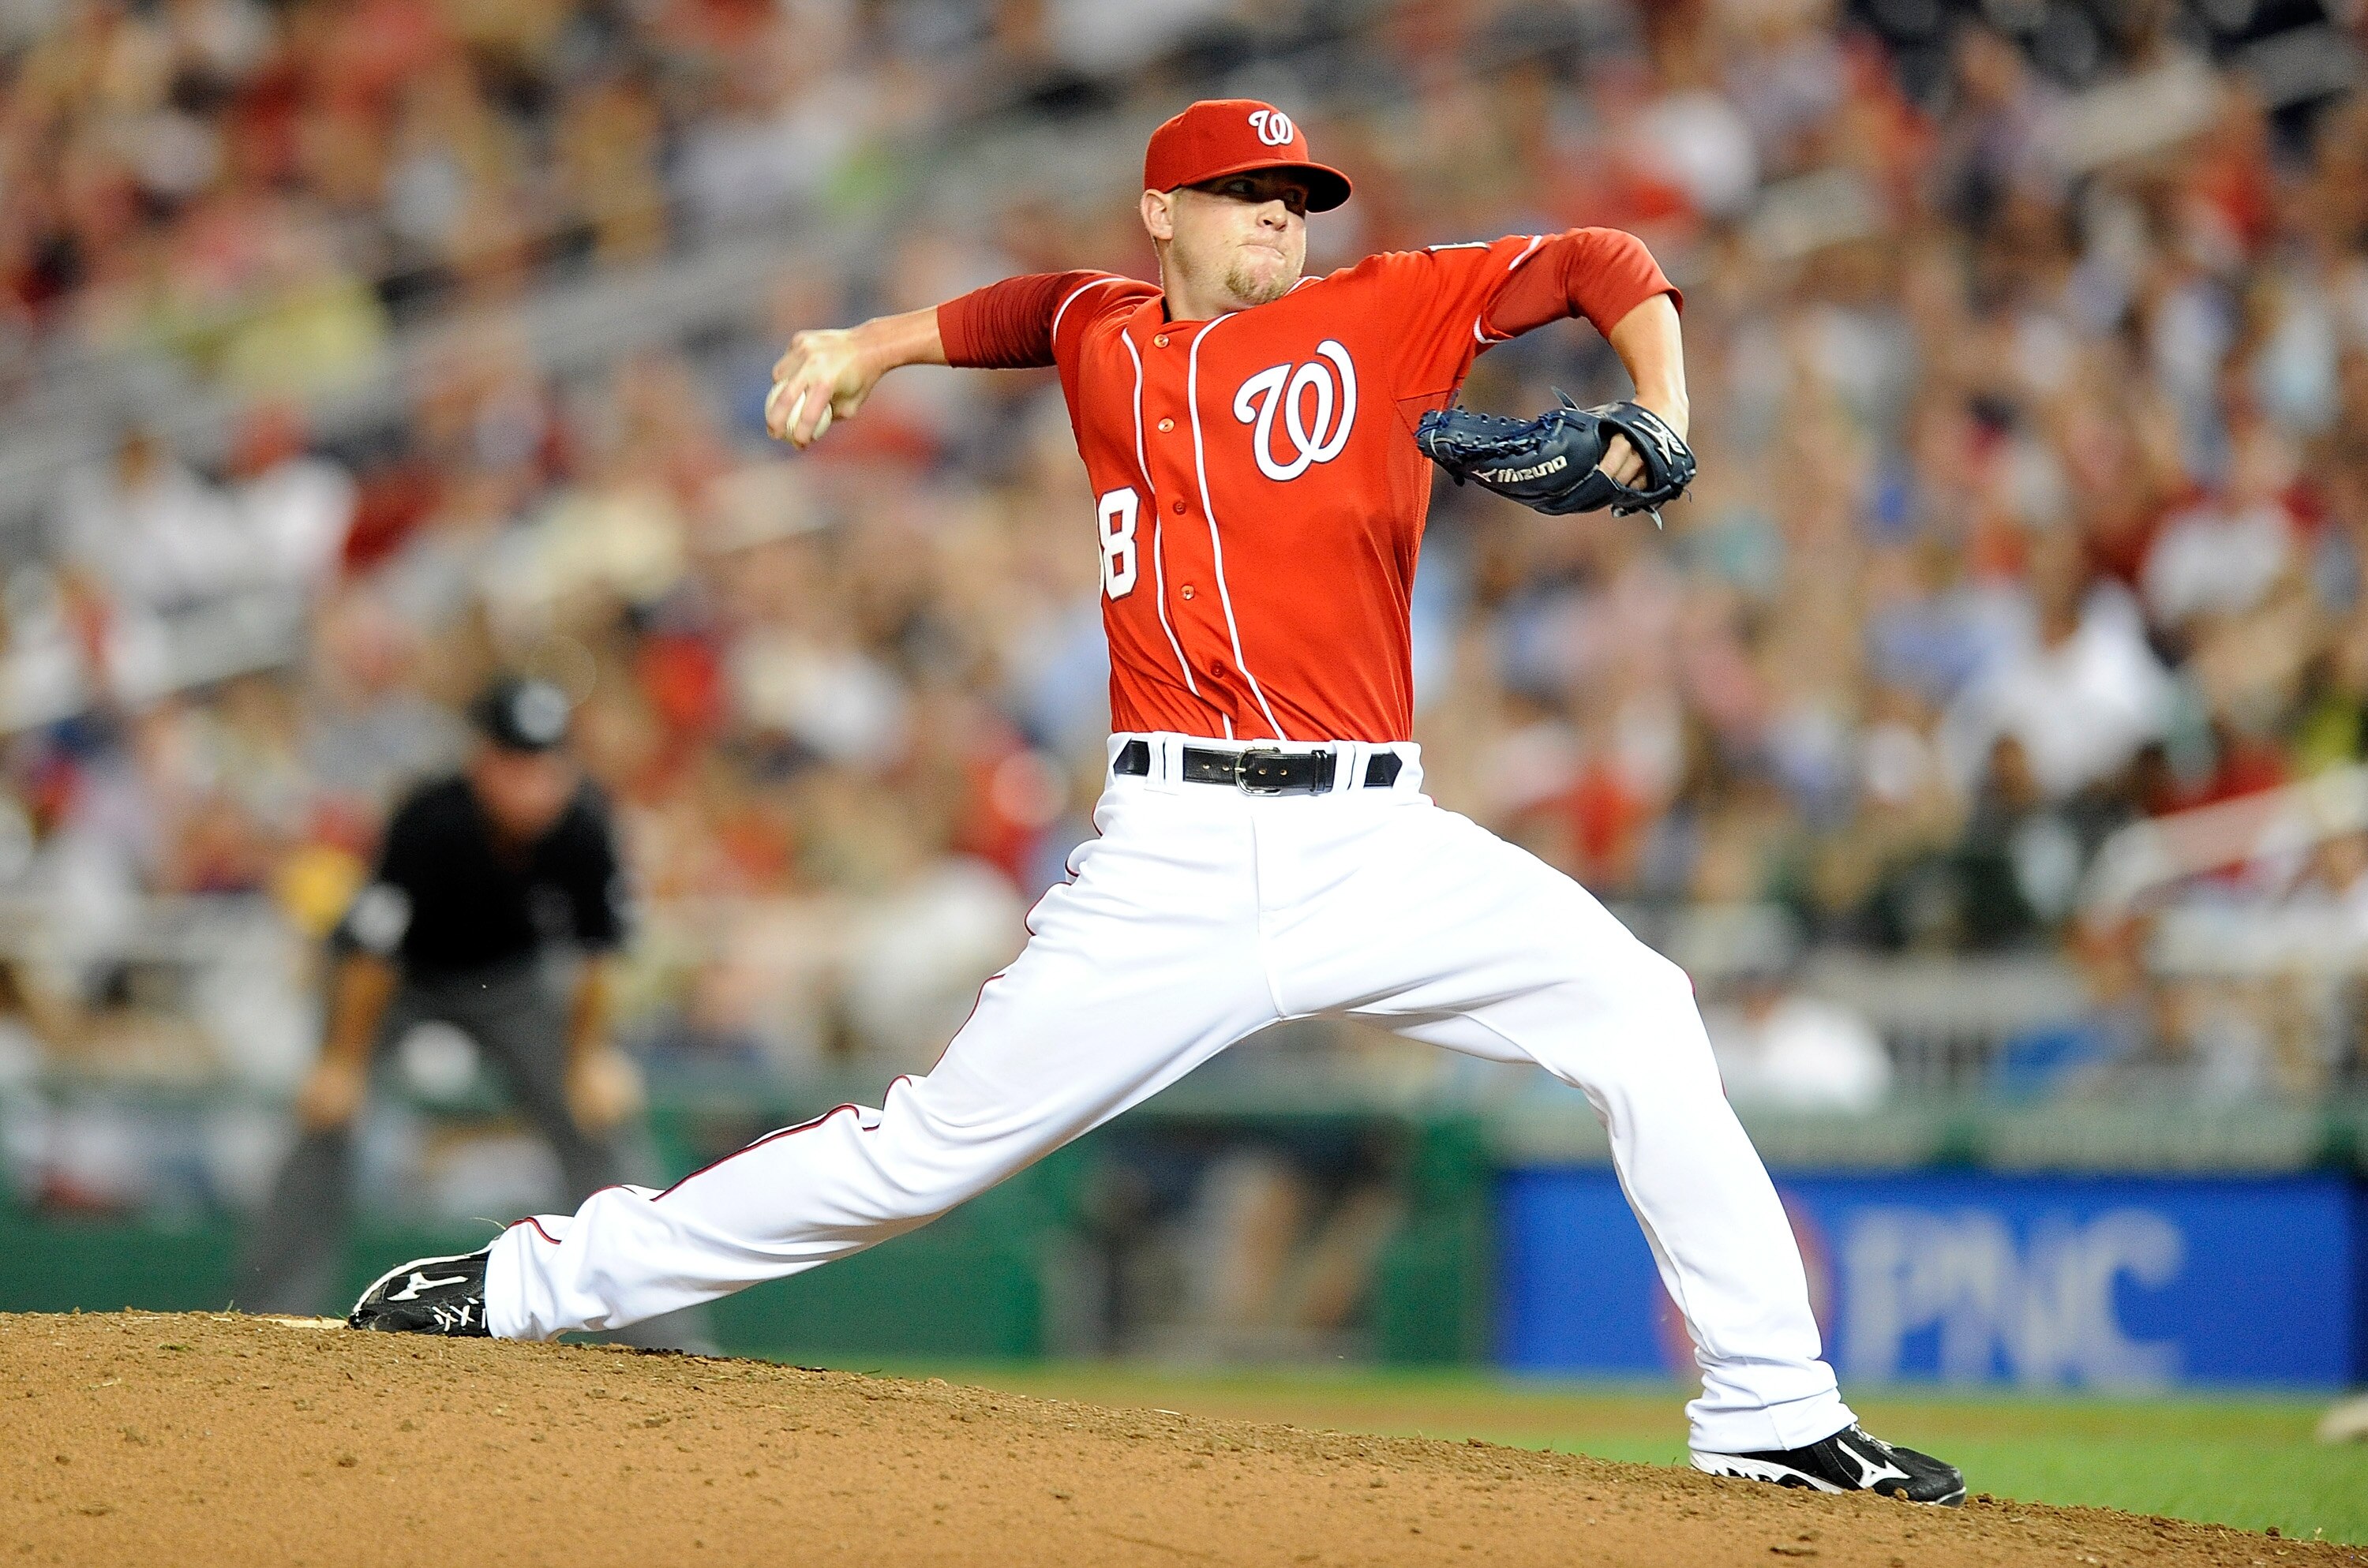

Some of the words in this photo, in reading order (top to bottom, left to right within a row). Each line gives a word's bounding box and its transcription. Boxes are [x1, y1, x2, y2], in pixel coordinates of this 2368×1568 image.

[1247, 109, 1294, 147] W
[1232, 339, 1358, 482] W
[1095, 485, 1141, 604] 8
[1843, 1210, 2183, 1389] PNC
